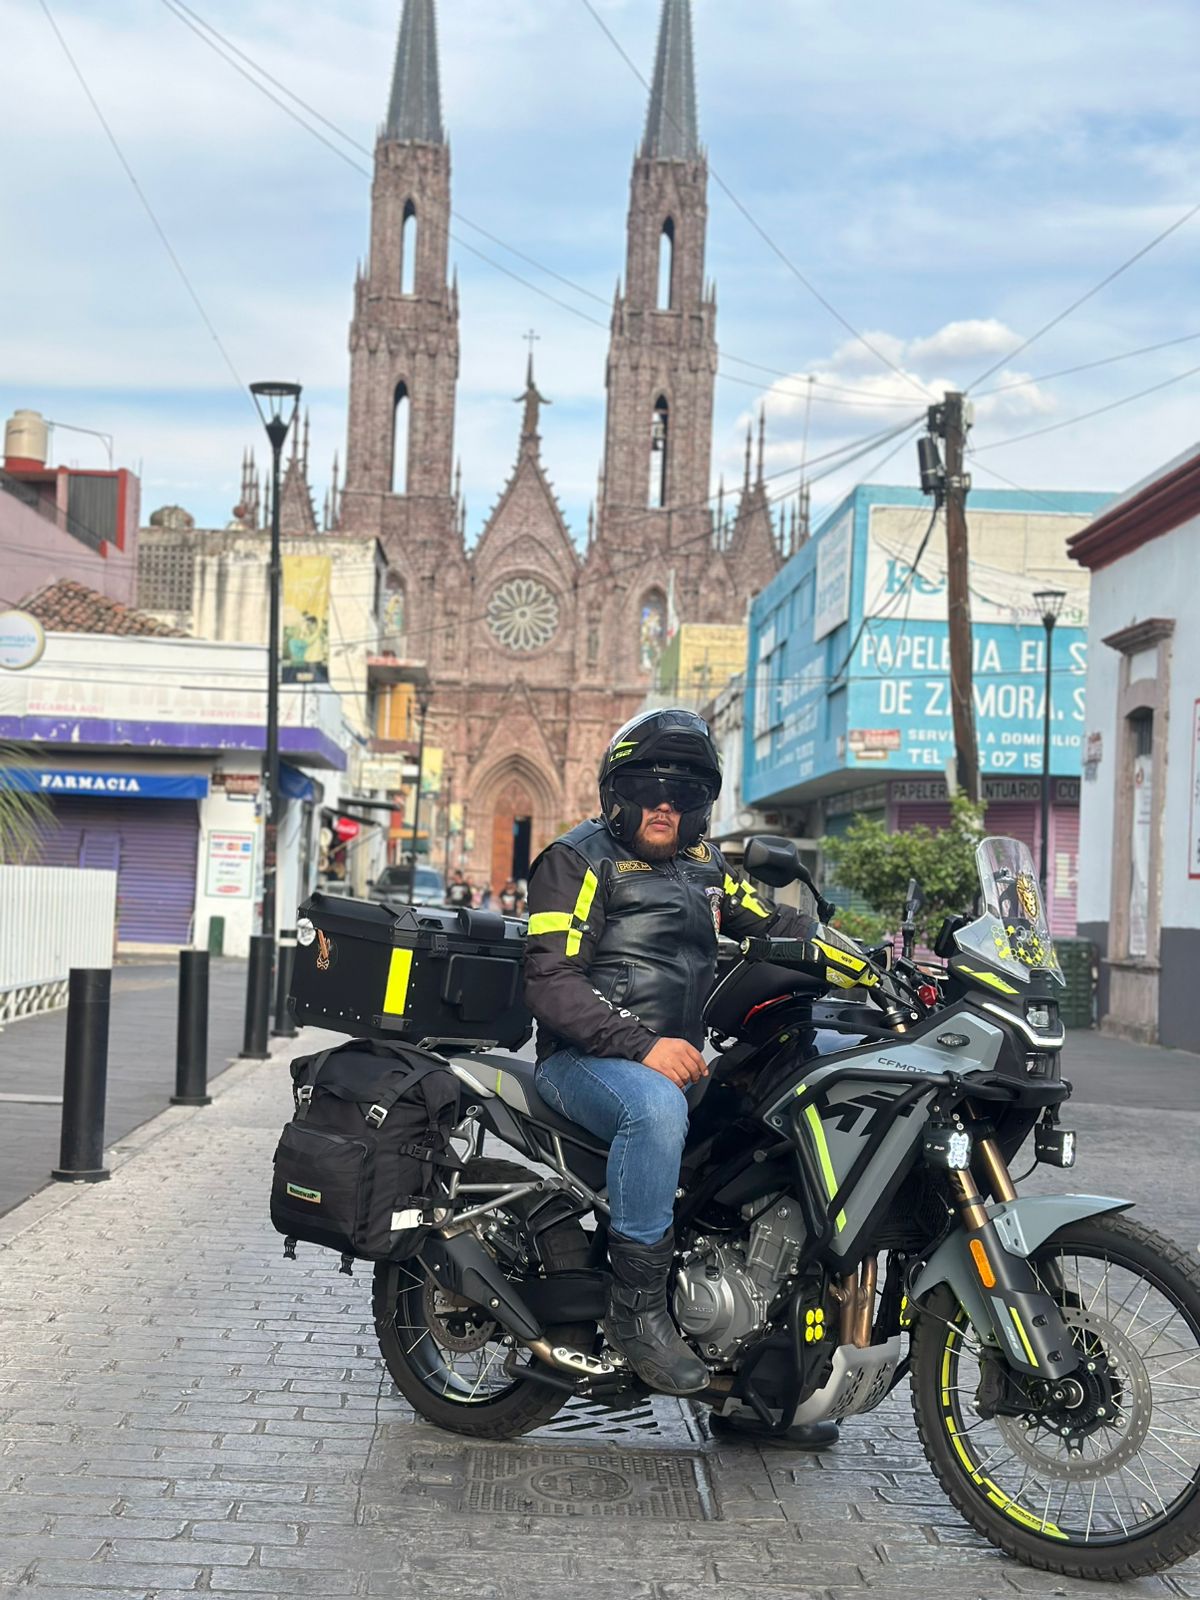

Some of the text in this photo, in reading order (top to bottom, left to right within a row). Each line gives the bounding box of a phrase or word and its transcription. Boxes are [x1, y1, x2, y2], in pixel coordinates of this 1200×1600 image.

[861, 634, 1001, 672] PAPELEIA
[879, 679, 913, 716] DE
[924, 681, 1064, 721] ZMORA.
[986, 731, 997, 745] A
[1001, 732, 1081, 747] DOMIILIO
[908, 748, 942, 764] TEL
[991, 751, 1018, 768] 07
[40, 774, 140, 792] FARMACIA
[894, 782, 1081, 800] PAPELER NTUARIO CO
[877, 1057, 928, 1073] CFMOT
